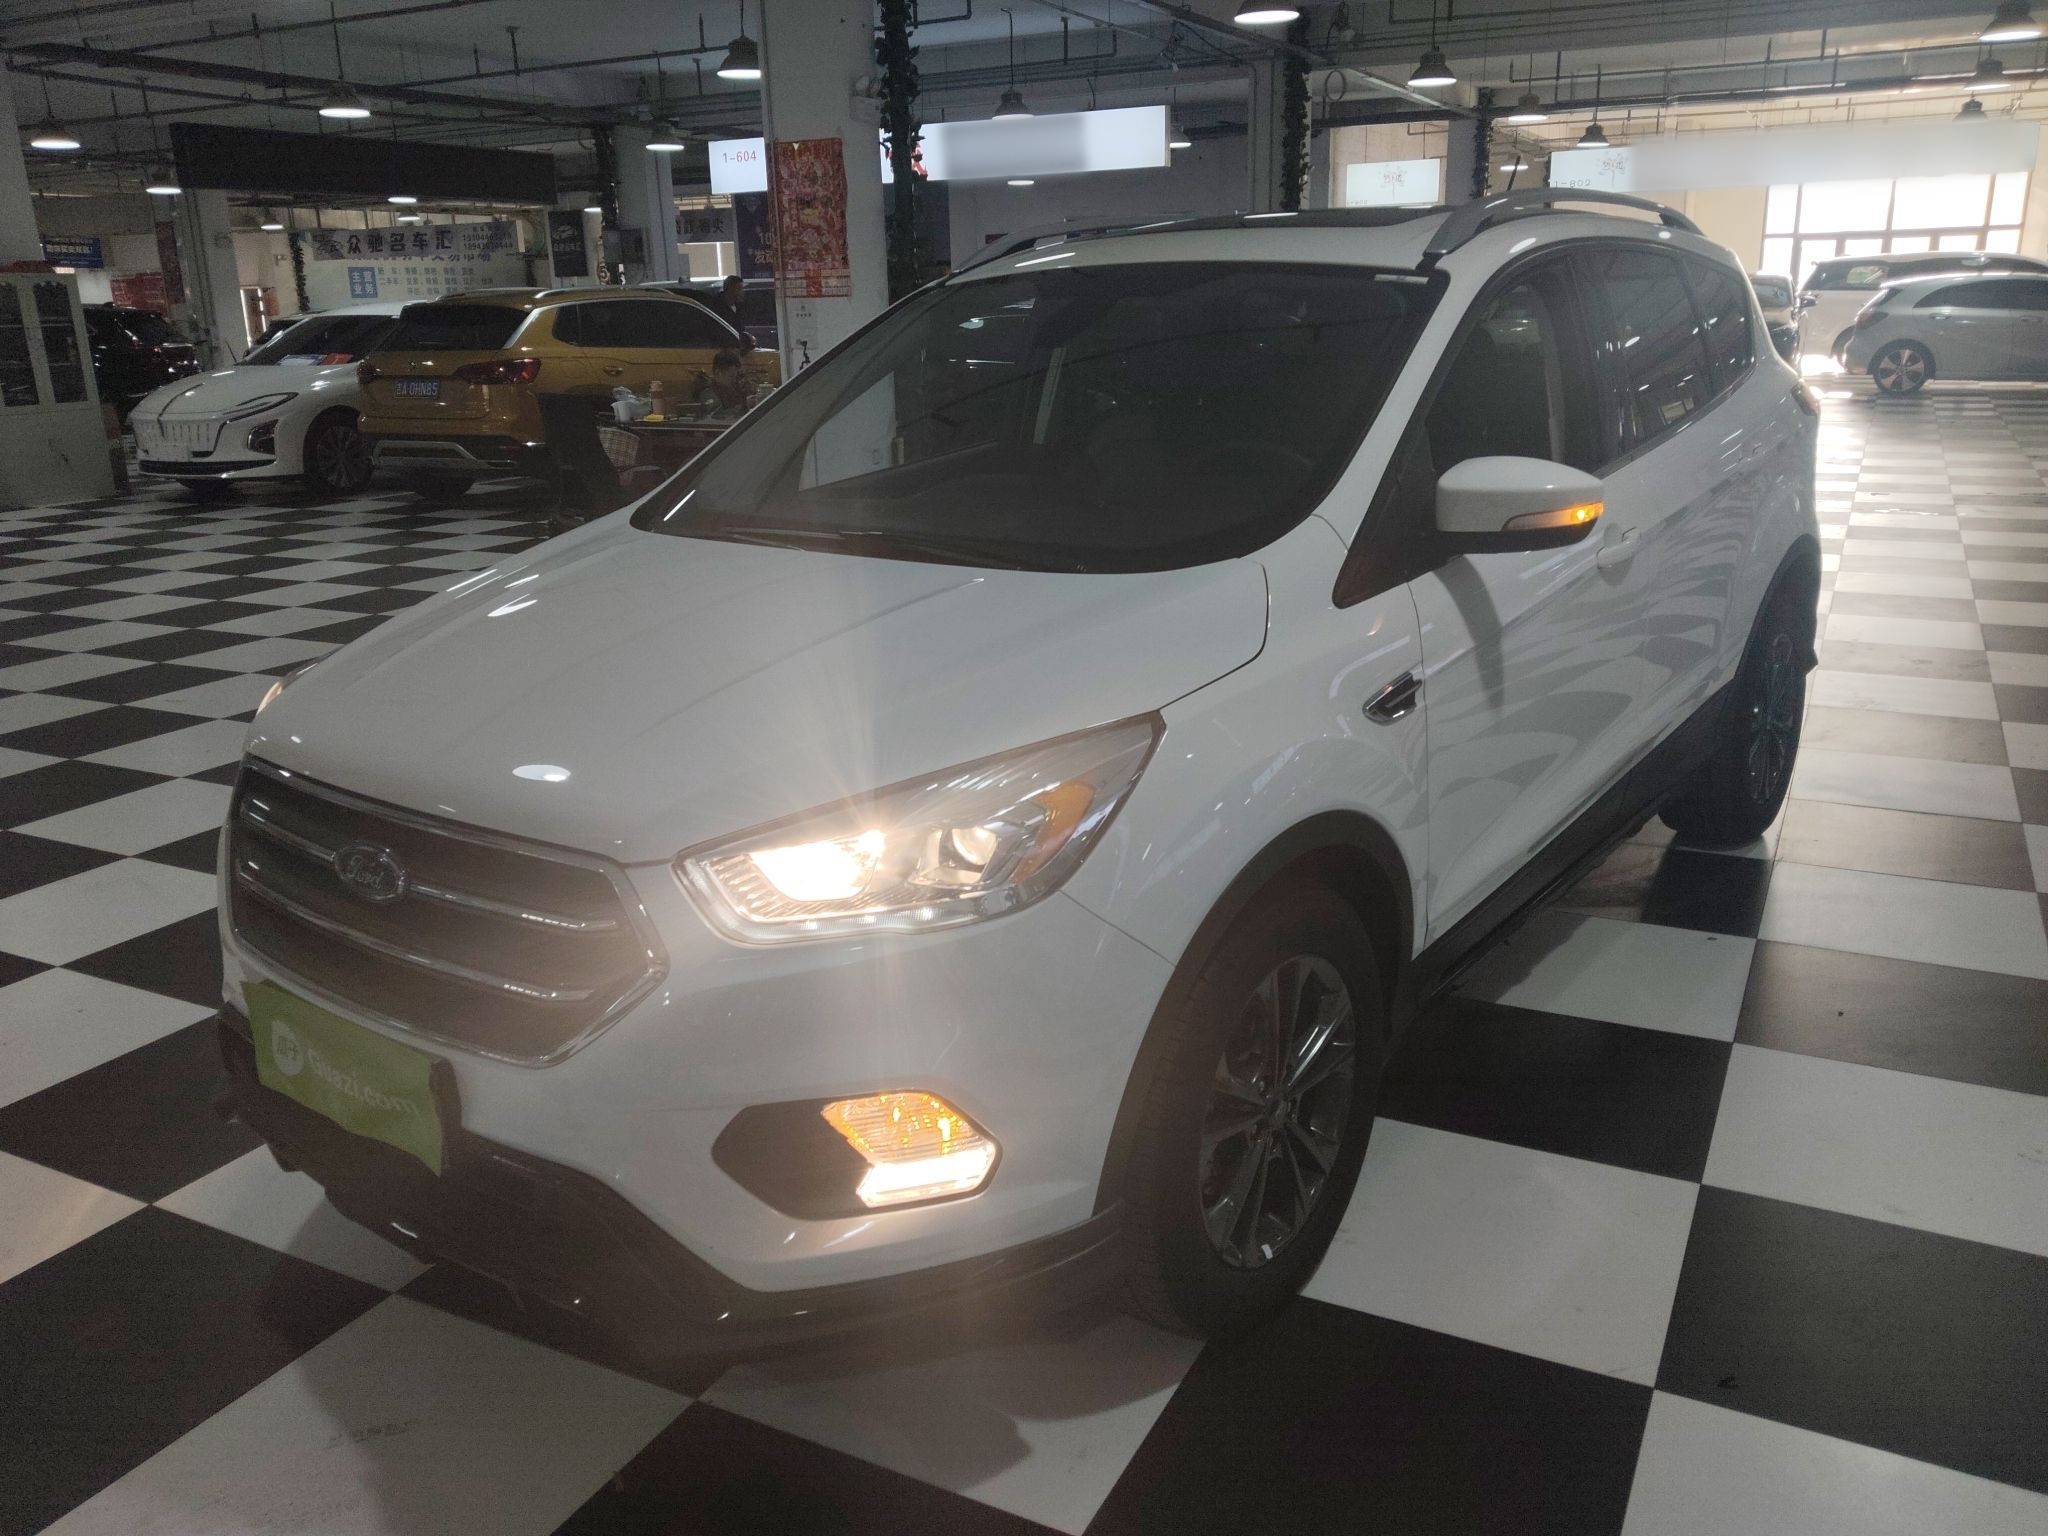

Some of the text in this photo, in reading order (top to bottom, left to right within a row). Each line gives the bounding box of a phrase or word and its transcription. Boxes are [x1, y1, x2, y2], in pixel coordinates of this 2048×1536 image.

[722, 149, 757, 163] 1-604
[1554, 179, 1592, 188] 1-802
[347, 230, 452, 254] 众驰名车汇
[306, 1047, 420, 1116] Guazi.com
